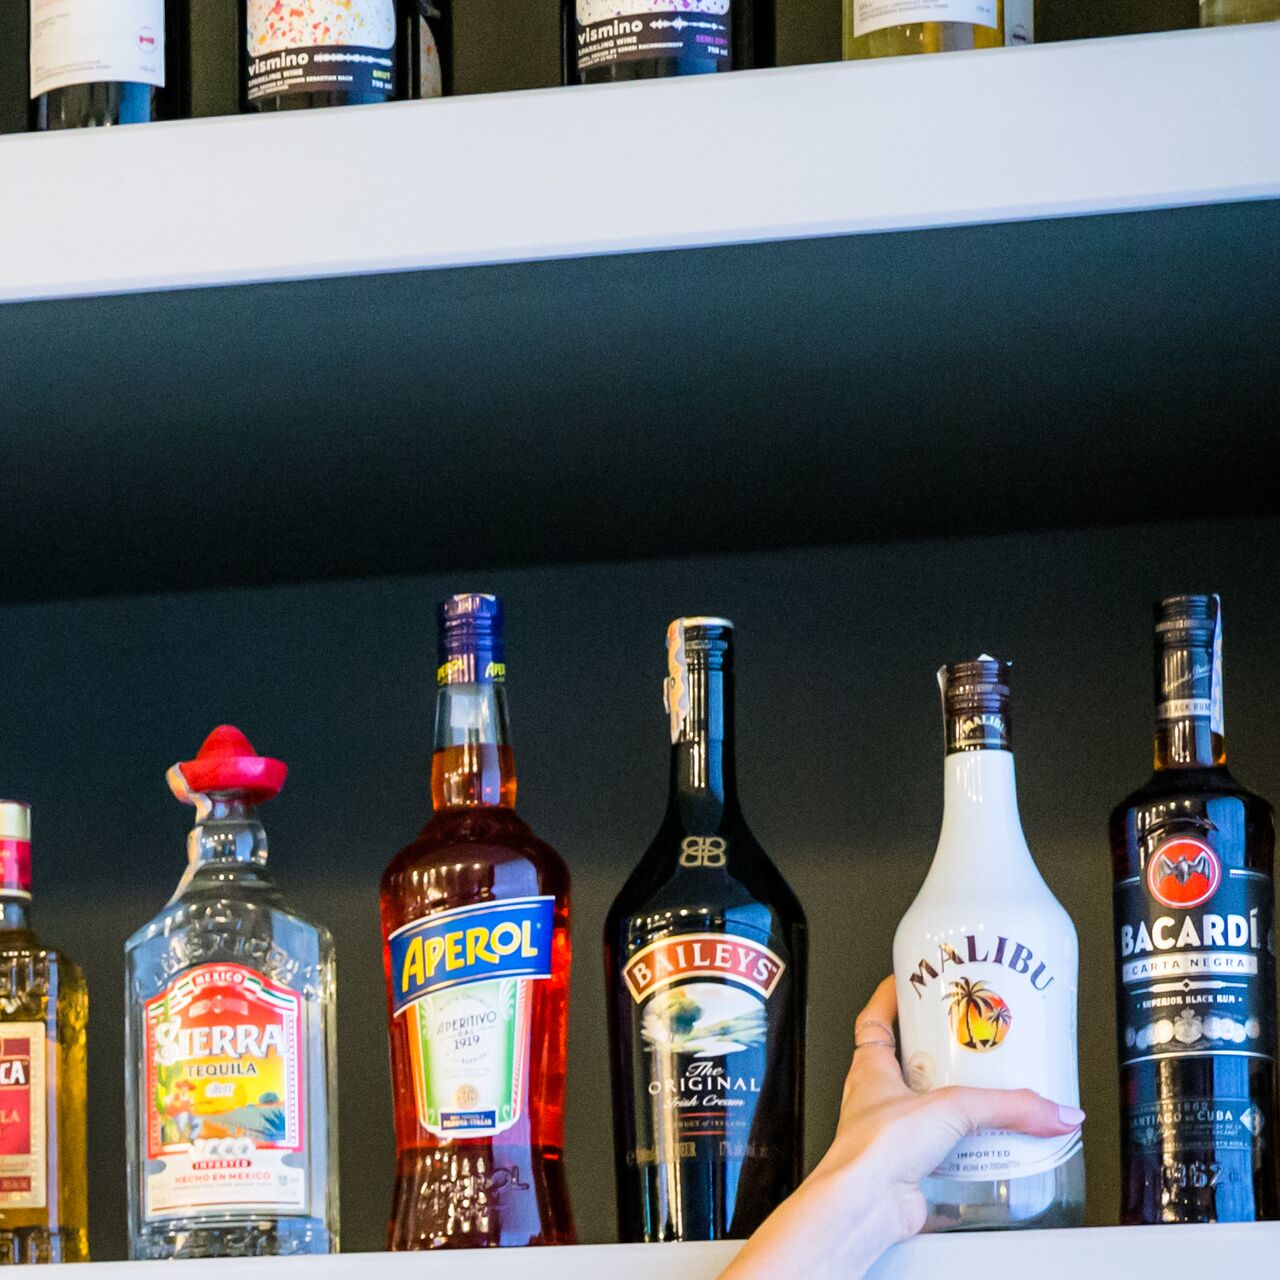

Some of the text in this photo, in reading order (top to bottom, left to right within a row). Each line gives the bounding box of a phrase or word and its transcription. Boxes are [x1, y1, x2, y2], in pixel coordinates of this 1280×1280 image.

[578, 20, 643, 45] vismino
[616, 36, 637, 45] WINE
[248, 52, 309, 76] vismino
[1121, 908, 1258, 957] BACARDÍ
[402, 920, 538, 993] APEROL
[633, 943, 773, 988] BAILEYS
[909, 935, 1055, 999] MALIBU
[1132, 958, 1244, 976] CARTA NEGRA
[195, 971, 243, 985] MEXICO
[1143, 994, 1236, 1009] SUPERIOR BLACK RUM
[437, 1010, 497, 1035] APERITIVO
[154, 1014, 289, 1067] SIERRA
[455, 1034, 480, 1050] 1919
[188, 1063, 257, 1077] TEQUILA
[686, 1062, 724, 1077] The
[648, 1077, 761, 1095] ORIGINAL
[702, 1094, 745, 1107] Cream
[1132, 1111, 1182, 1126] ANTIAGO
[1197, 1110, 1233, 1122] CUBA
[957, 1149, 1010, 1159] IMPORTED
[175, 1171, 272, 1184] HECHO EN MEXICO
